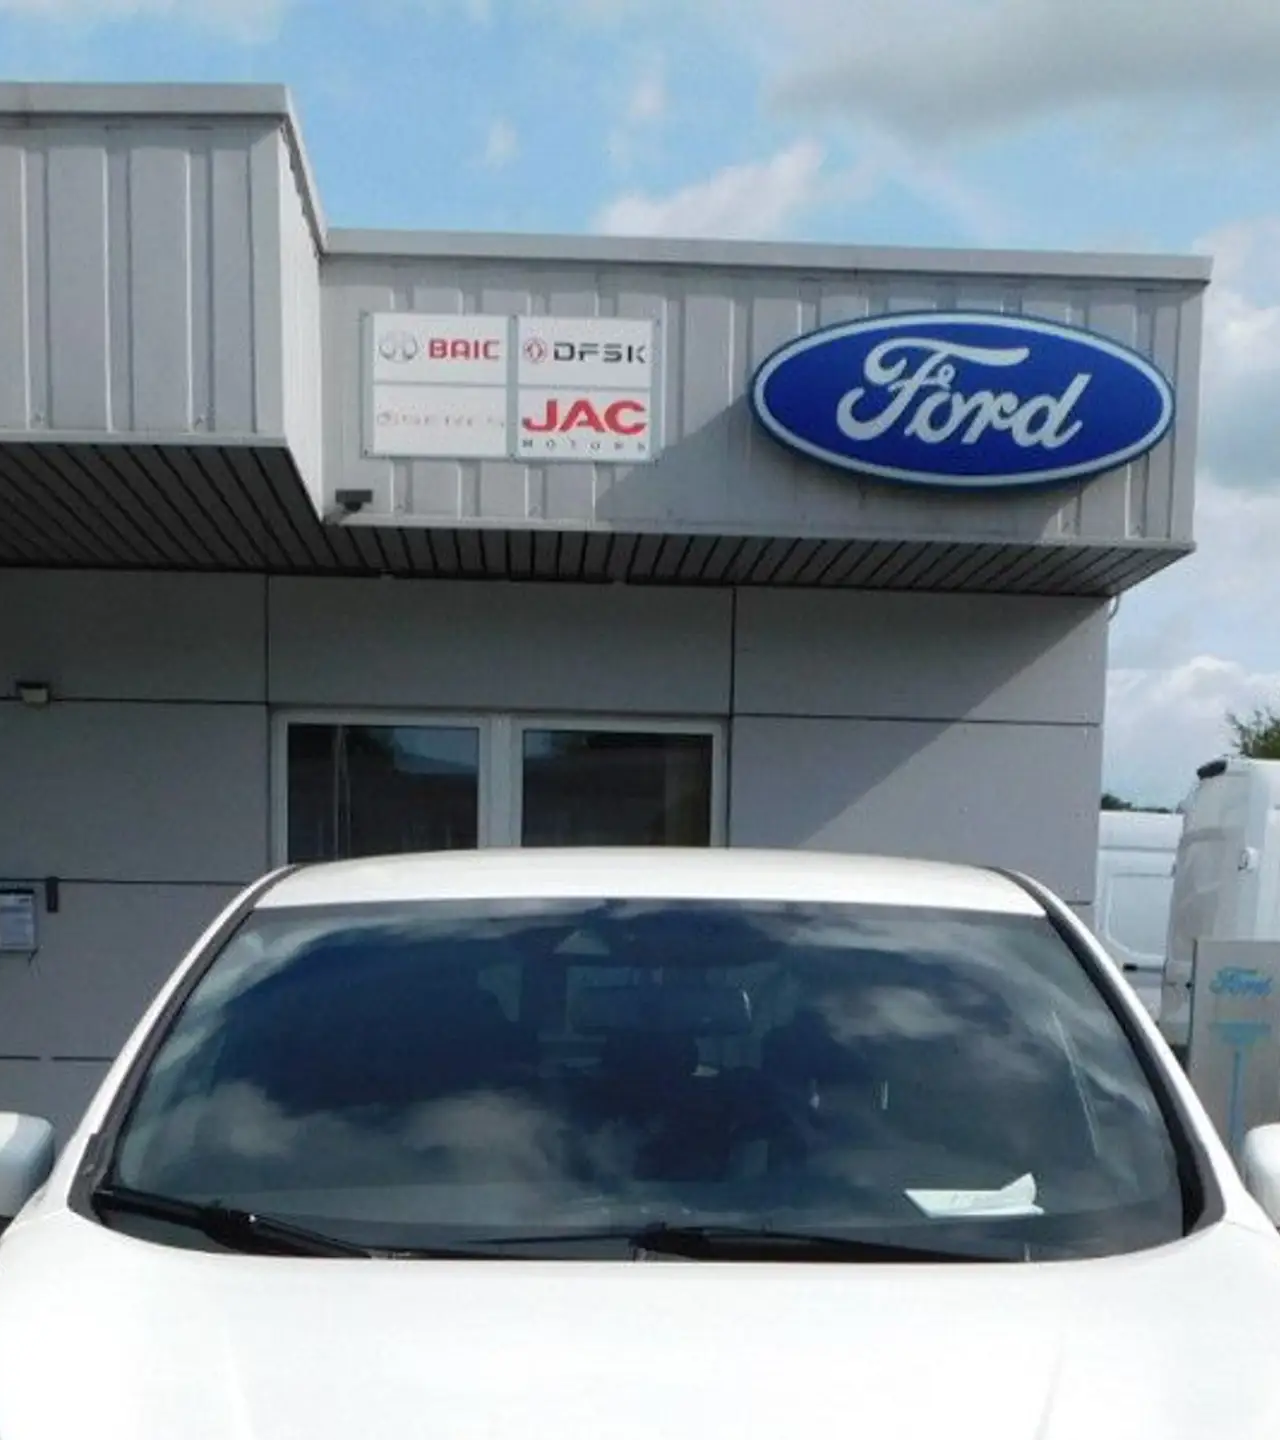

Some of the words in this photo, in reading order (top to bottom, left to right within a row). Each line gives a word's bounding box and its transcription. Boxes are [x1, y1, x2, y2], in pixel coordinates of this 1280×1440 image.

[428, 337, 501, 362] BAIC
[553, 341, 647, 364] DFSK
[835, 337, 1091, 450] Ford
[522, 398, 648, 436] JAC
